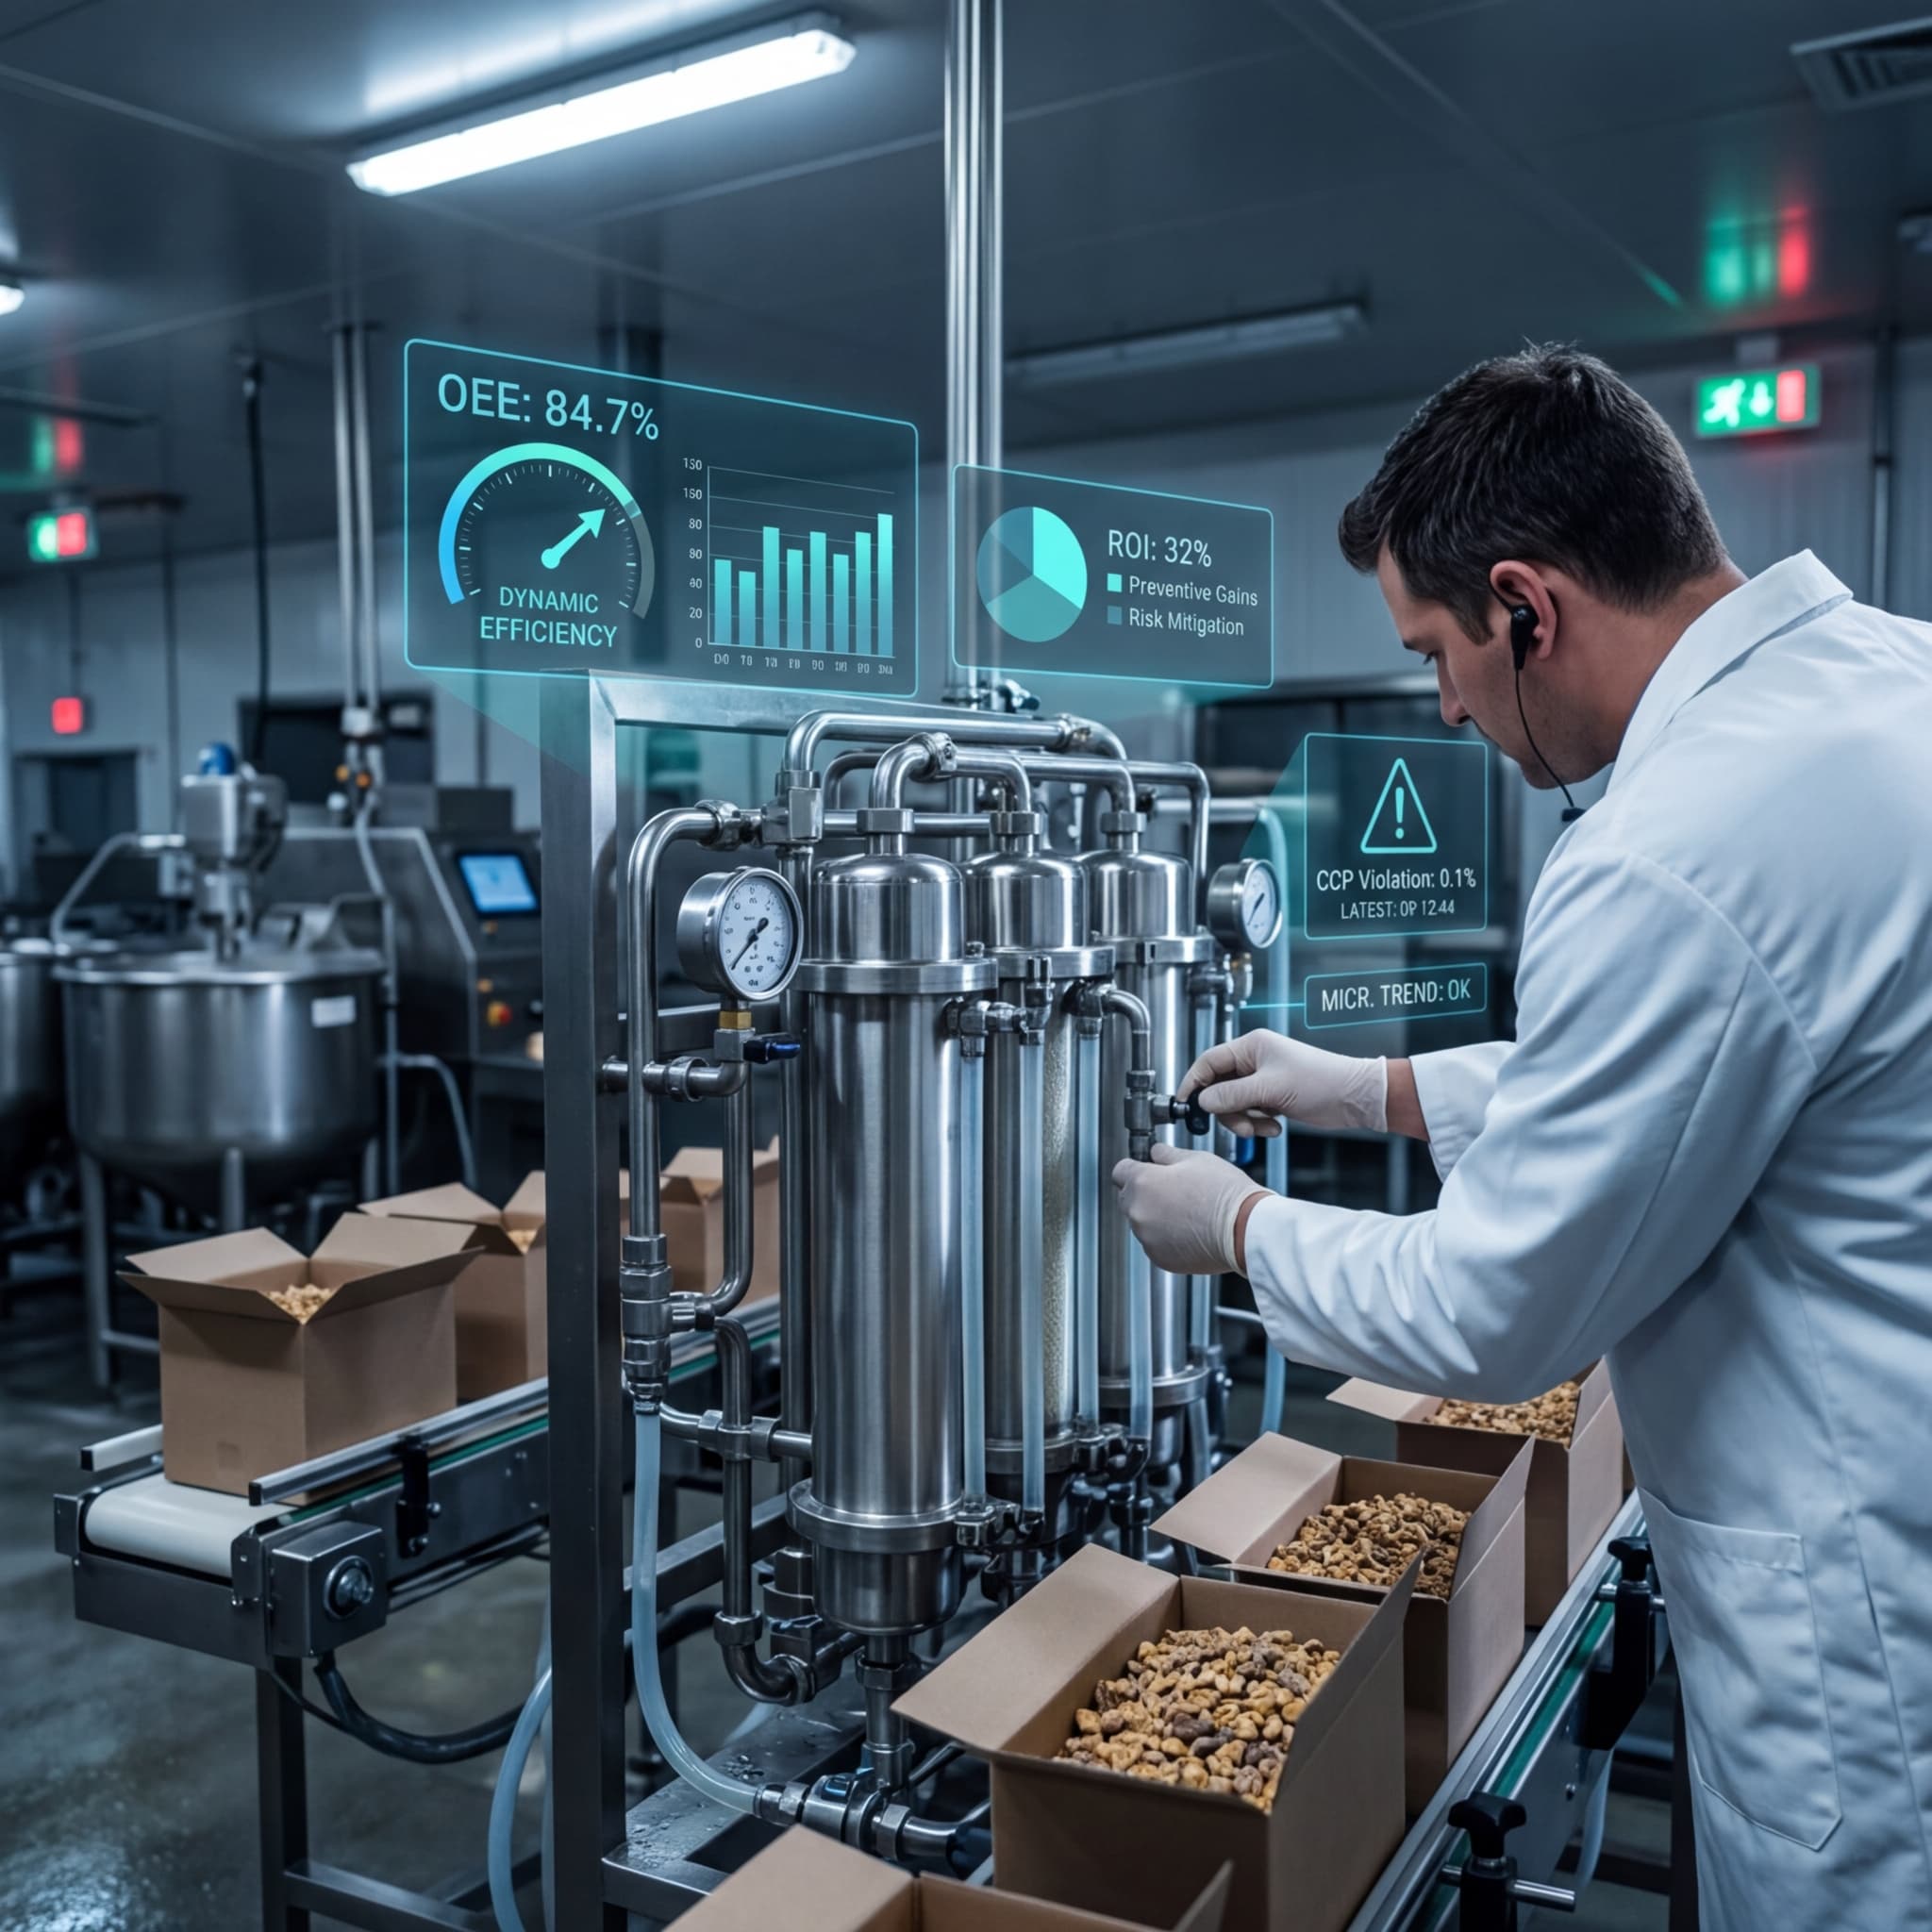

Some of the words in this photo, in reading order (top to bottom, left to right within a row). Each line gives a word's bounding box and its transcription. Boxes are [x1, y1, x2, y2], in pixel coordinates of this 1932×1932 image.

[438, 373, 531, 423] OEE:
[545, 389, 659, 441] 84.7%
[1108, 528, 1157, 561] ROI:
[1164, 536, 1212, 567] 32%
[499, 586, 599, 614] DYNAMIC
[1129, 575, 1211, 602] Preventive
[1216, 585, 1258, 607] Gains
[689, 607, 703, 619] 20
[1129, 608, 1163, 629] Risk
[1168, 611, 1244, 638] Mitigation
[480, 615, 618, 648] EFFICIENCY
[1316, 869, 1355, 891] CCP
[1358, 868, 1435, 891] Violation:
[1440, 867, 1477, 889] 0.1%
[1341, 901, 1397, 920] LATEST:
[1322, 986, 1374, 1012] MICR.
[1380, 980, 1443, 1007] TREND:
[1448, 977, 1472, 1001] OK
